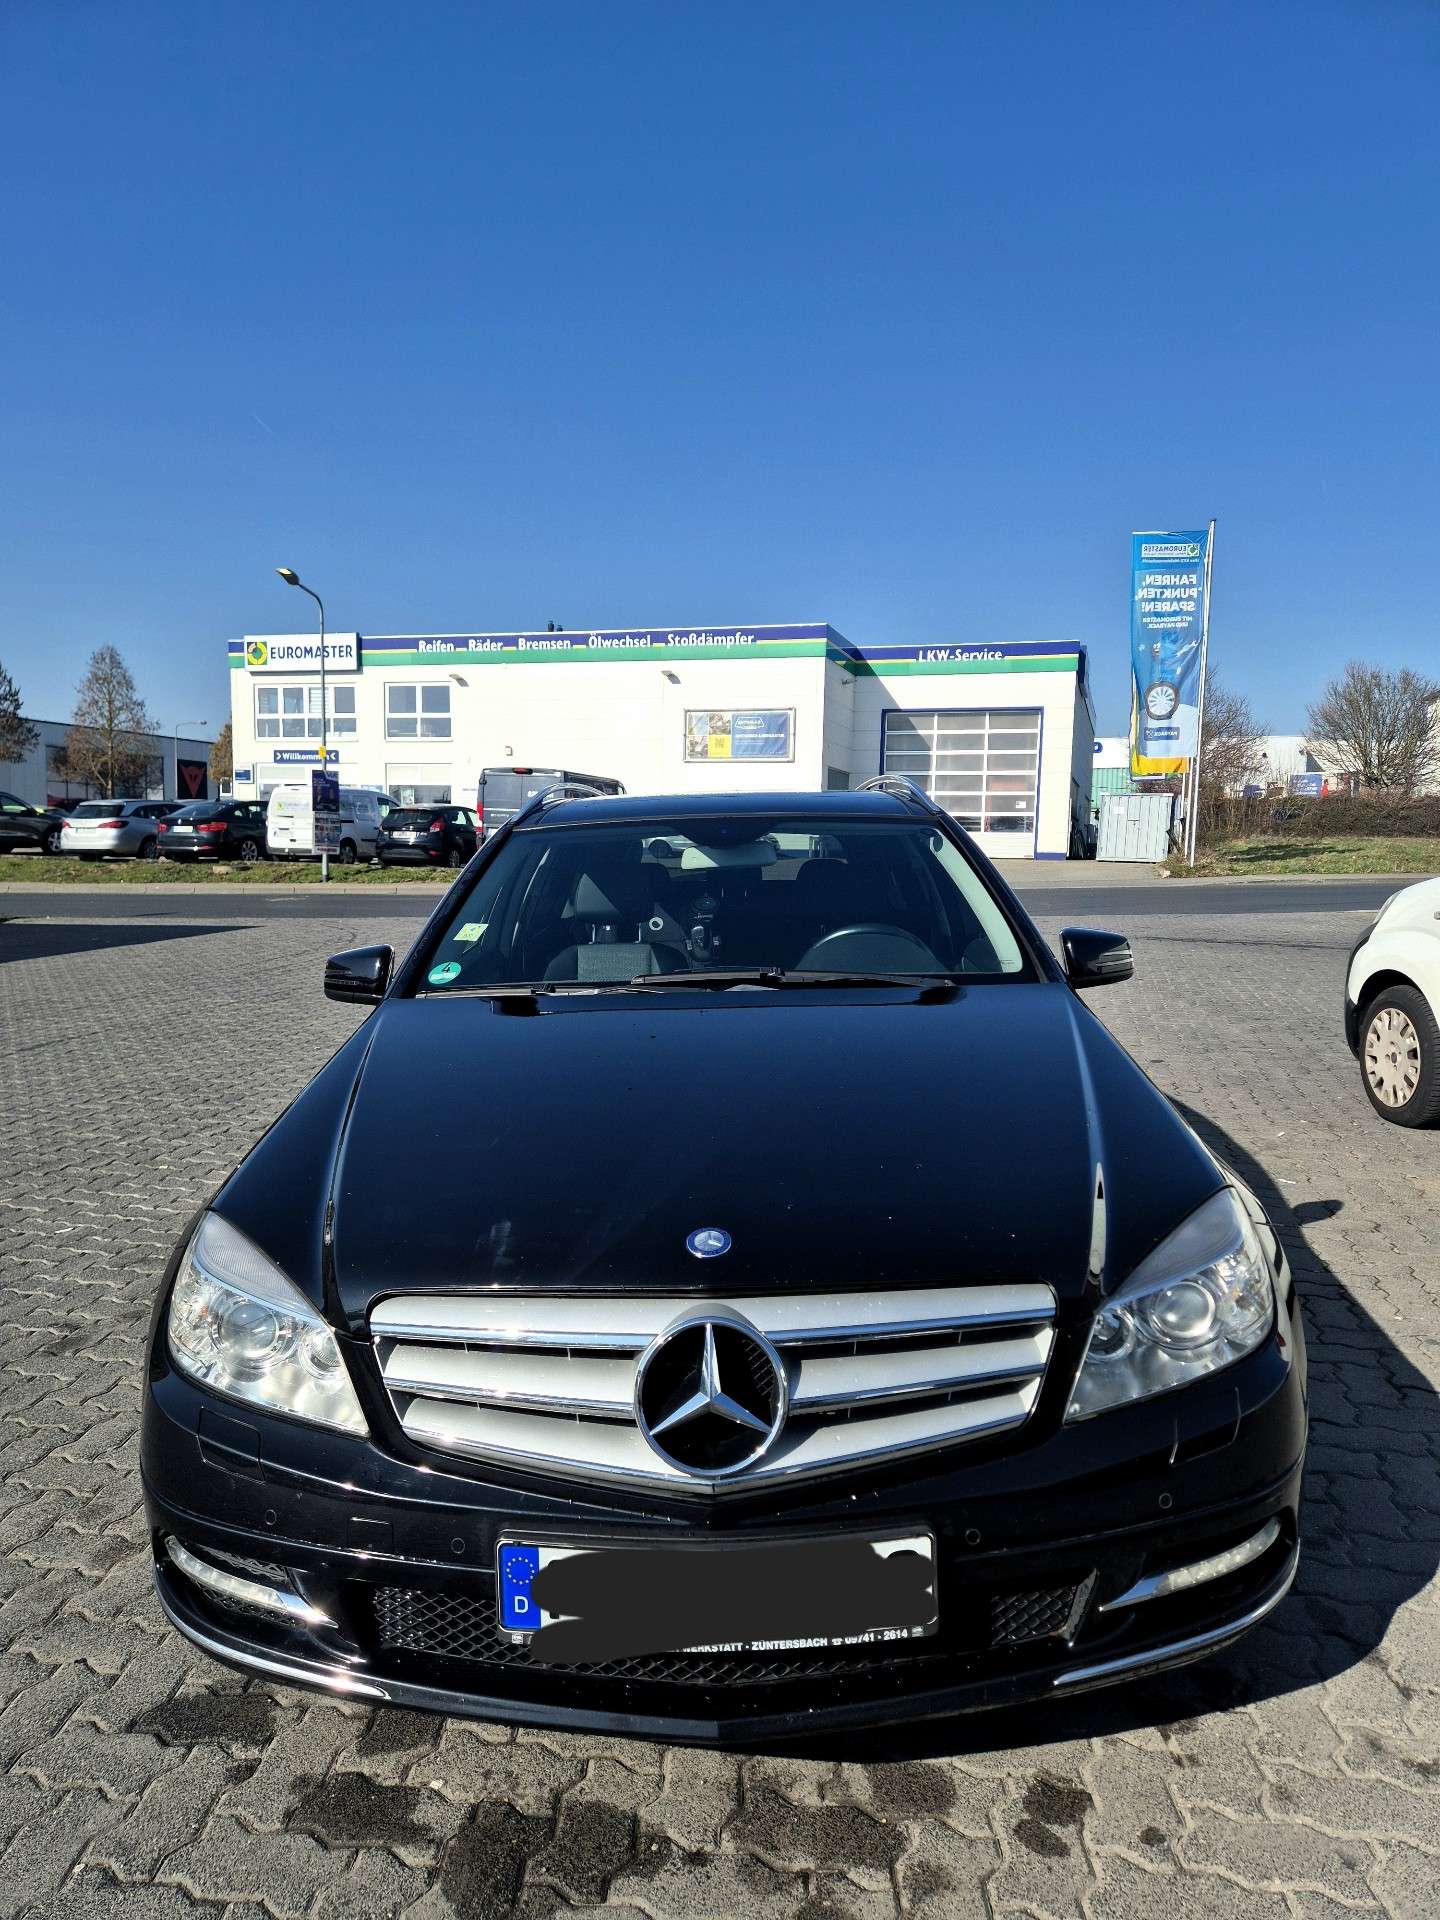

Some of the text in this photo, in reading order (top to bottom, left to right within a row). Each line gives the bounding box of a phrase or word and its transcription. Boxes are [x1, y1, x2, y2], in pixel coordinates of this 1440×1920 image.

[418, 632, 754, 653] Reifen Räder Bremsen Ölwechsel Stoßdämpfer
[270, 645, 353, 660] EUROMASTER
[918, 648, 1003, 663] LKW-Service
[282, 752, 330, 761] Willkommn
[514, 1595, 529, 1614] D
[751, 1637, 828, 1651] ZÜNTERSBACH
[883, 1628, 908, 1641] 2614
